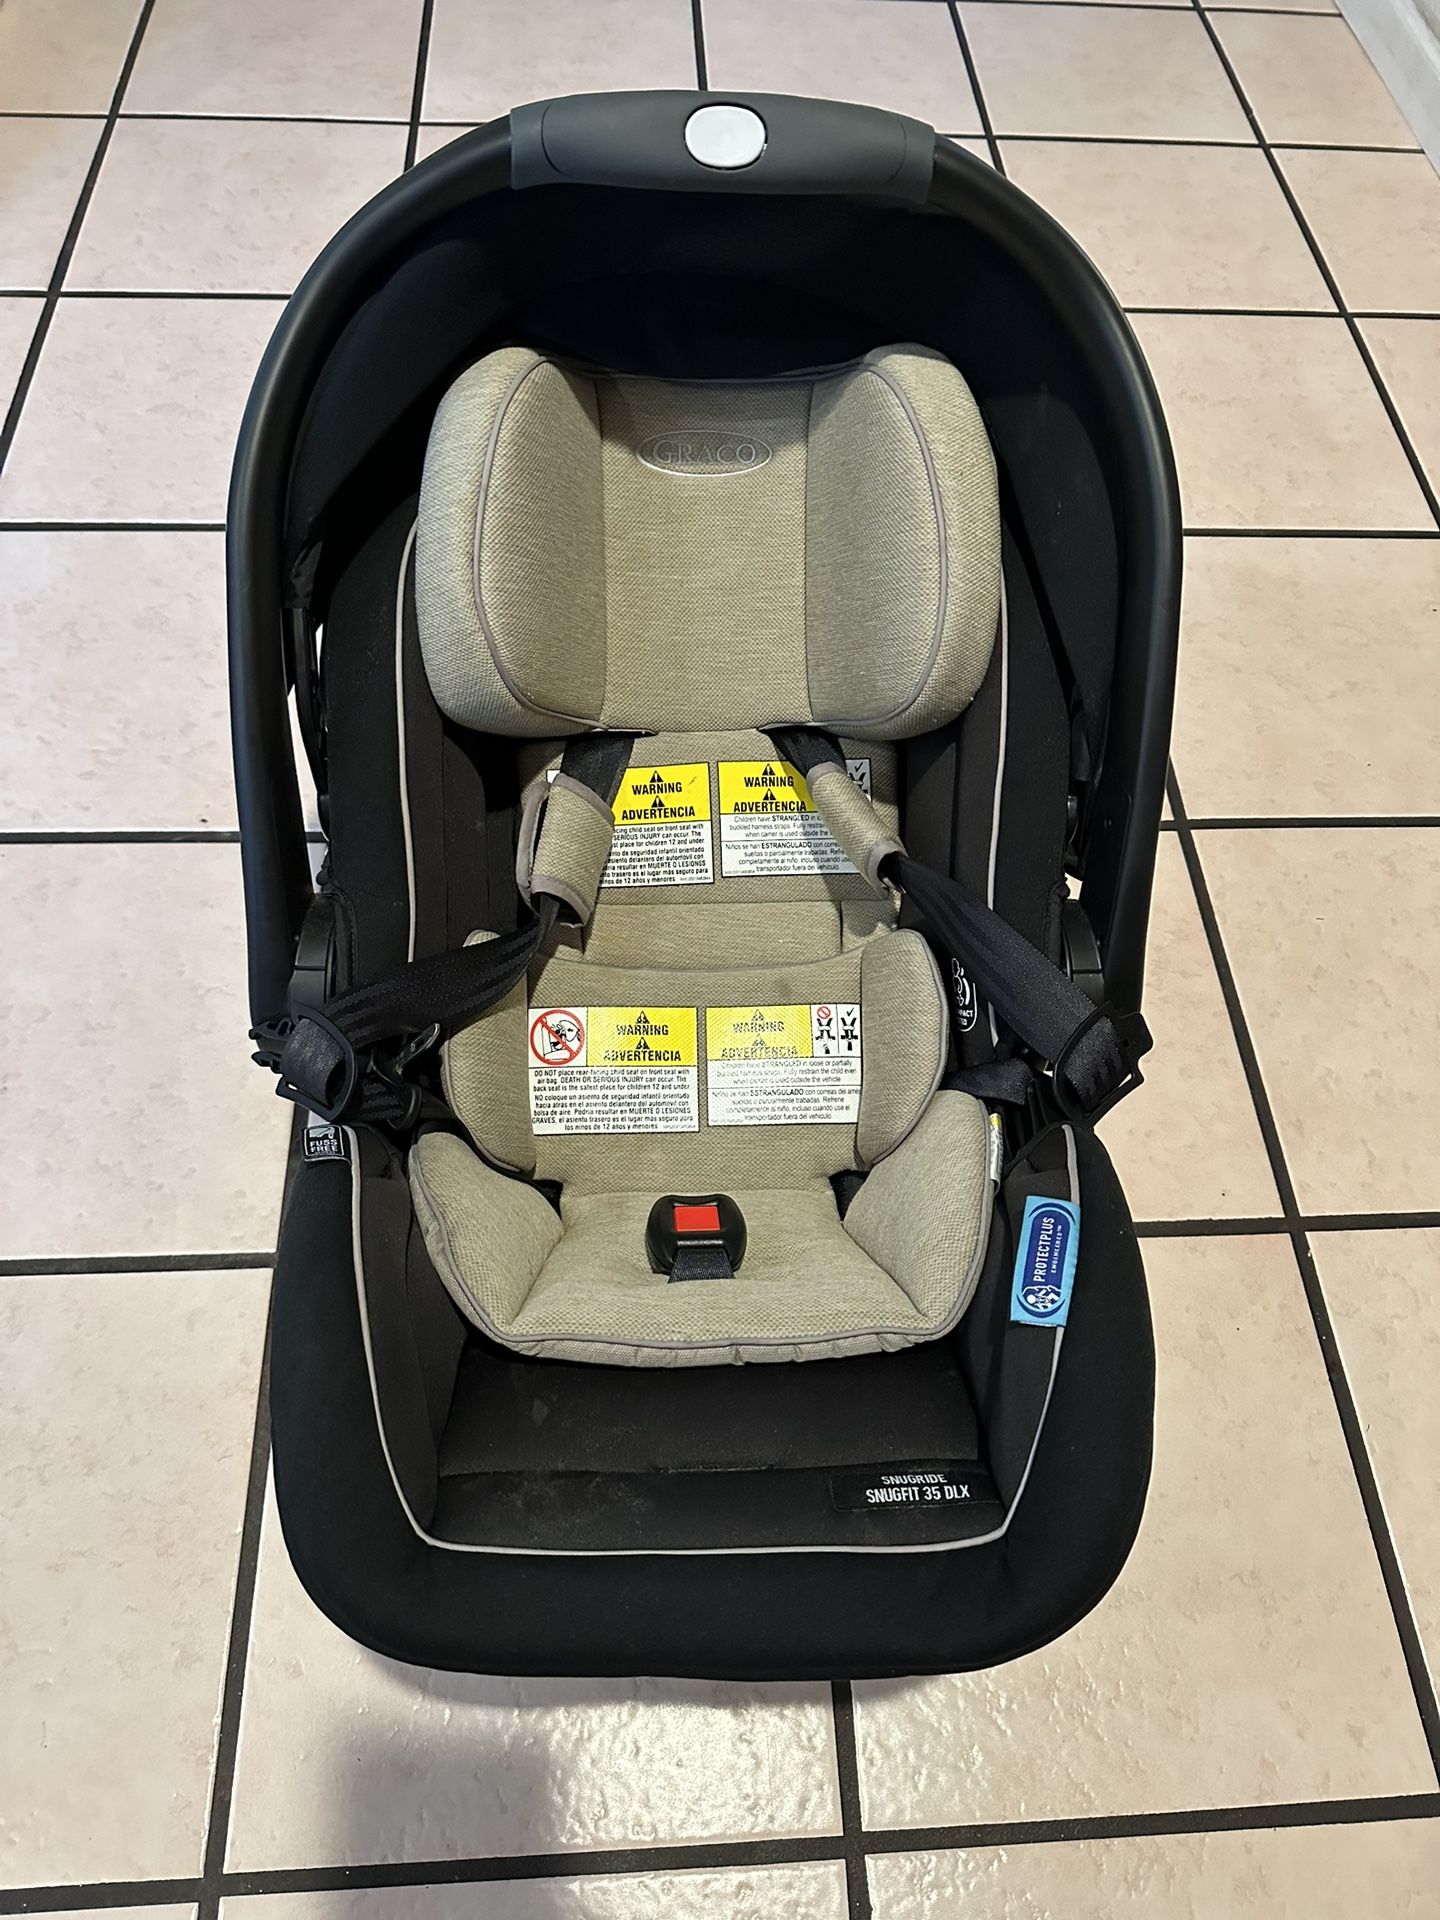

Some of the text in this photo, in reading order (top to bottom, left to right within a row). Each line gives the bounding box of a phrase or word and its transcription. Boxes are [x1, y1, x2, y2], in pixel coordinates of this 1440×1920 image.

[653, 440, 755, 464] GRACO
[744, 776, 794, 787] WARNING
[632, 782, 682, 795] WARNING
[622, 806, 695, 820] ADVERTENCIA
[734, 802, 806, 812] ADVERTENCIA
[616, 1025, 668, 1036] WARNING
[733, 1021, 785, 1033] WARNING
[604, 1050, 681, 1062] ADVERTENCIA
[721, 1046, 798, 1058] ADVERTENCIA
[310, 1139, 337, 1147] FUSS
[1033, 1217, 1055, 1282] PROTECTPLUS
[881, 1474, 948, 1485] SNUGRIDE
[866, 1484, 970, 1503] SNUGFIT 35 DLX
